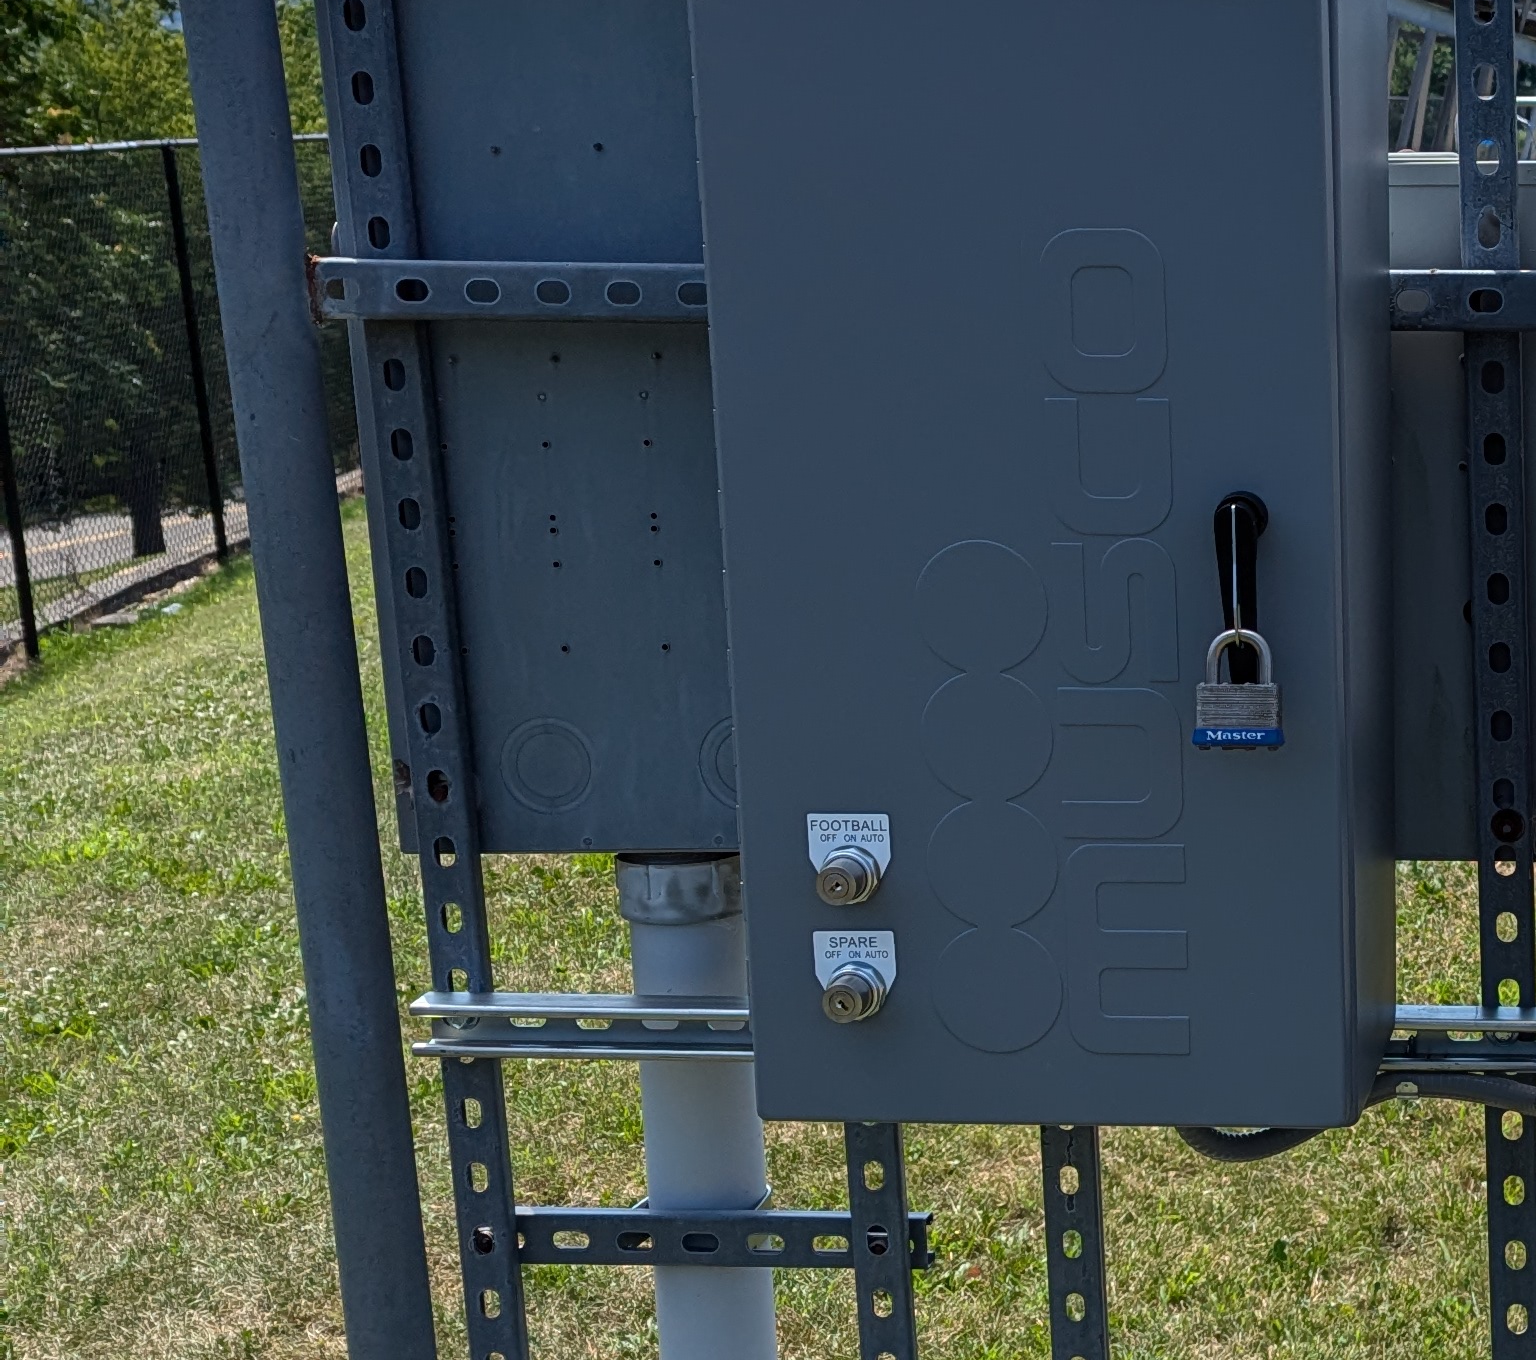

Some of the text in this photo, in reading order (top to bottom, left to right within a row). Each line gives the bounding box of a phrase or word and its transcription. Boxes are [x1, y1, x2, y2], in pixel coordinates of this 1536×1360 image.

[1206, 730, 1266, 741] Master
[810, 819, 888, 832] FOOTBALL
[820, 833, 885, 843] OFF ON AUTO
[829, 936, 878, 949] SPARE
[824, 950, 889, 960] OFF ON AUTO
